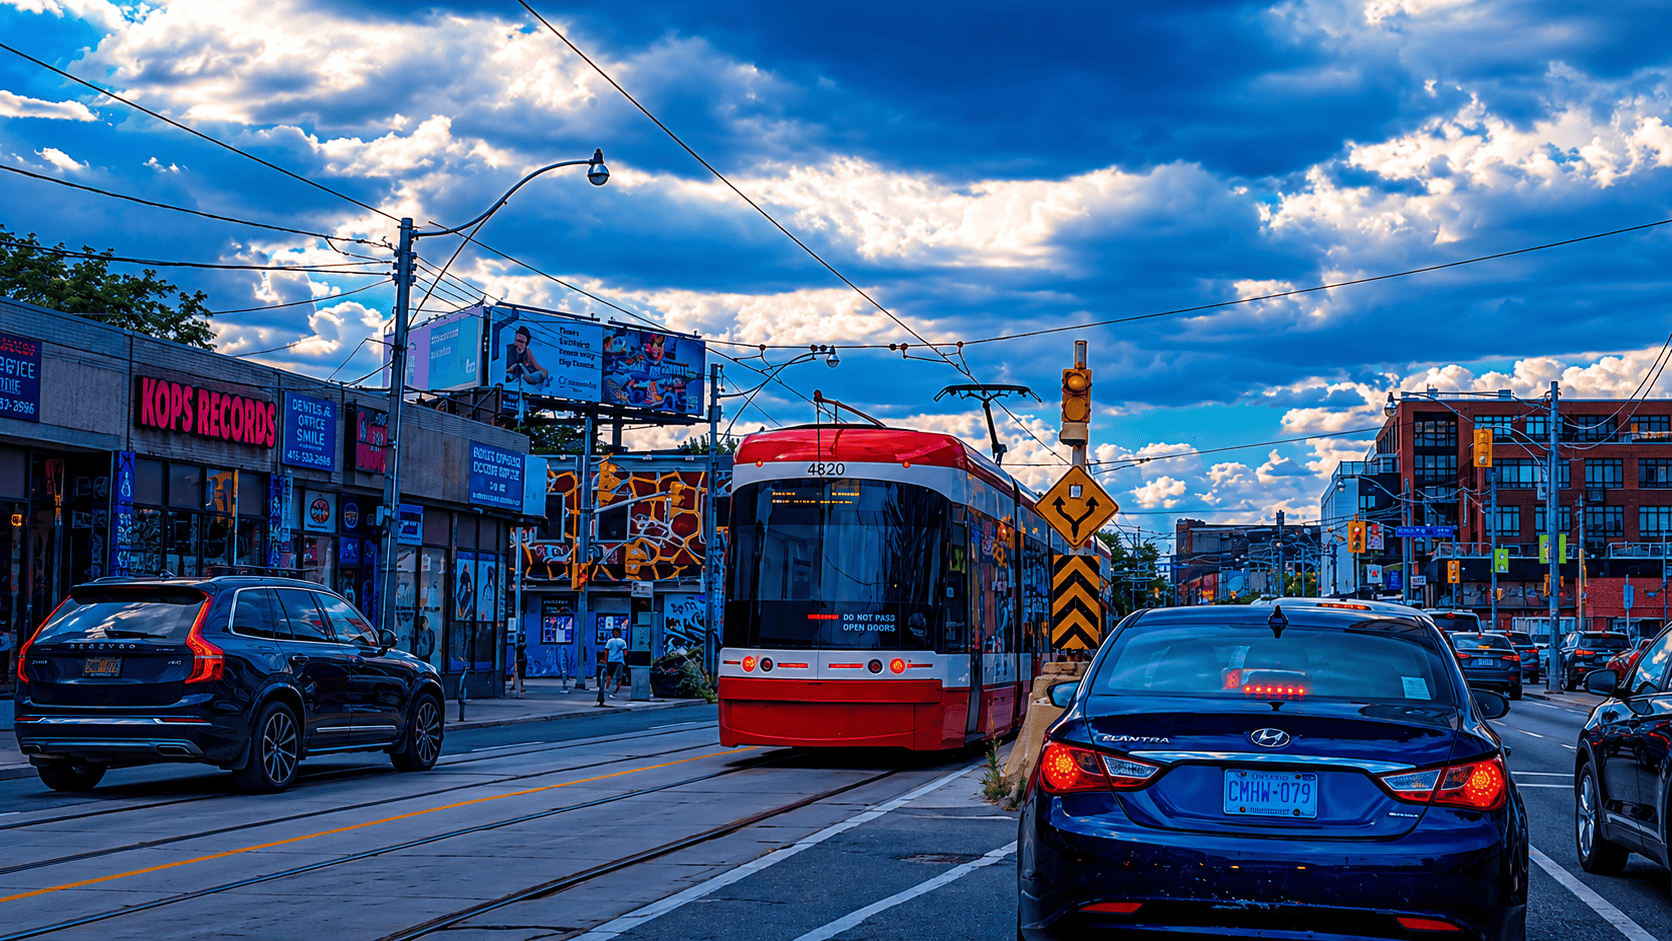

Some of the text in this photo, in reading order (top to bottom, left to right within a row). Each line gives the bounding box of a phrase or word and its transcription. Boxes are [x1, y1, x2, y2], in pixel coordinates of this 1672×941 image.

[141, 376, 276, 448] KOPS RECORDS
[296, 428, 325, 446] SMILE
[807, 462, 845, 476] 4820
[843, 613, 896, 622] DO NOT PASS
[843, 623, 896, 632] OPEN DOORS
[1102, 735, 1170, 744] ELANTRA
